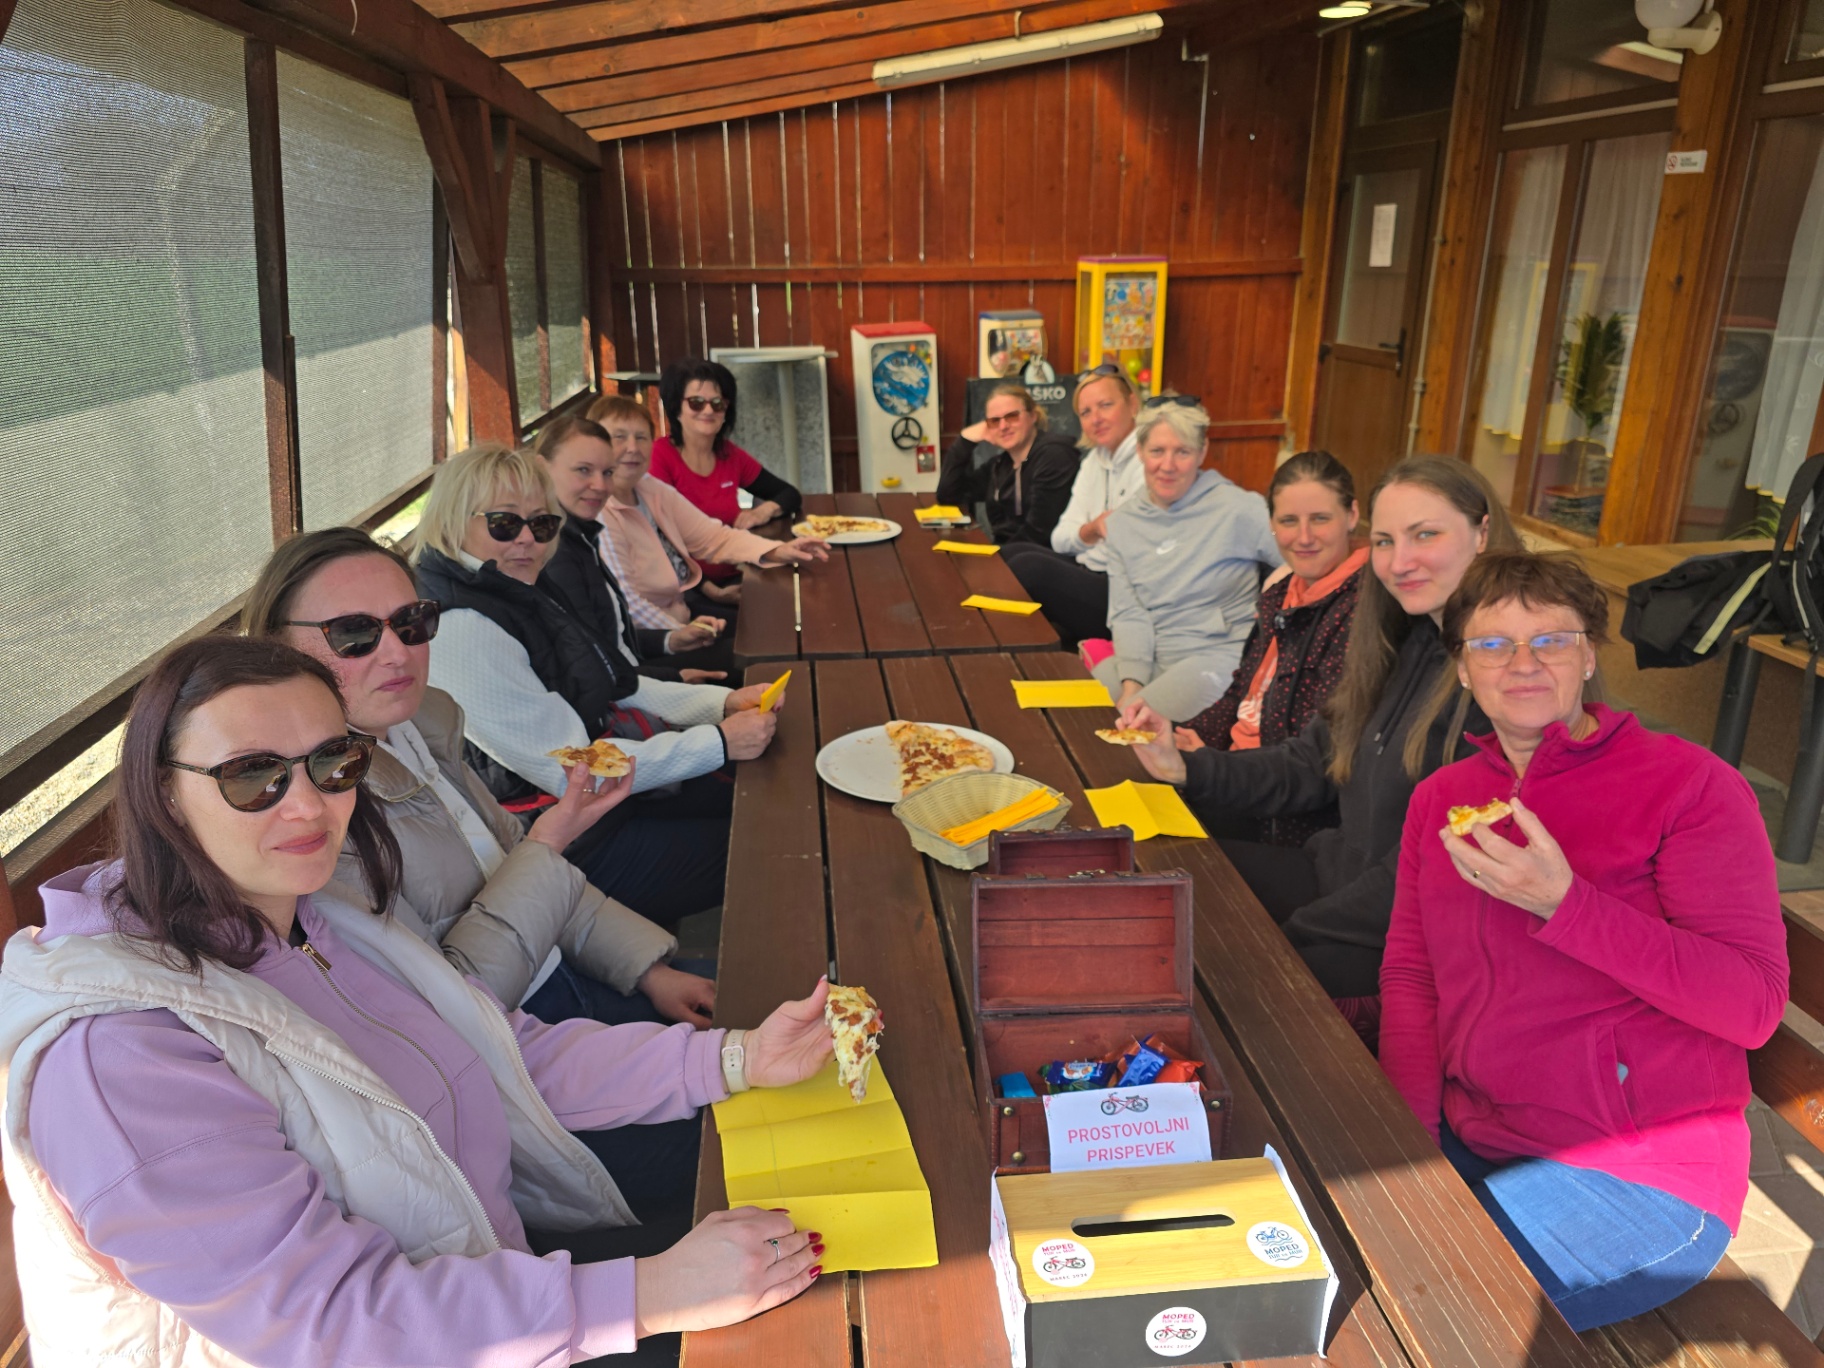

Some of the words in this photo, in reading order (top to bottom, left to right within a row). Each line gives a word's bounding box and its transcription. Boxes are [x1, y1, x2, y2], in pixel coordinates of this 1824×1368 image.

[1067, 1117, 1190, 1144] PROSTOVOLJNI
[1087, 1140, 1176, 1163] PRISPEVEK
[1042, 1243, 1074, 1252] MOPED
[1264, 1243, 1299, 1254] MOPED
